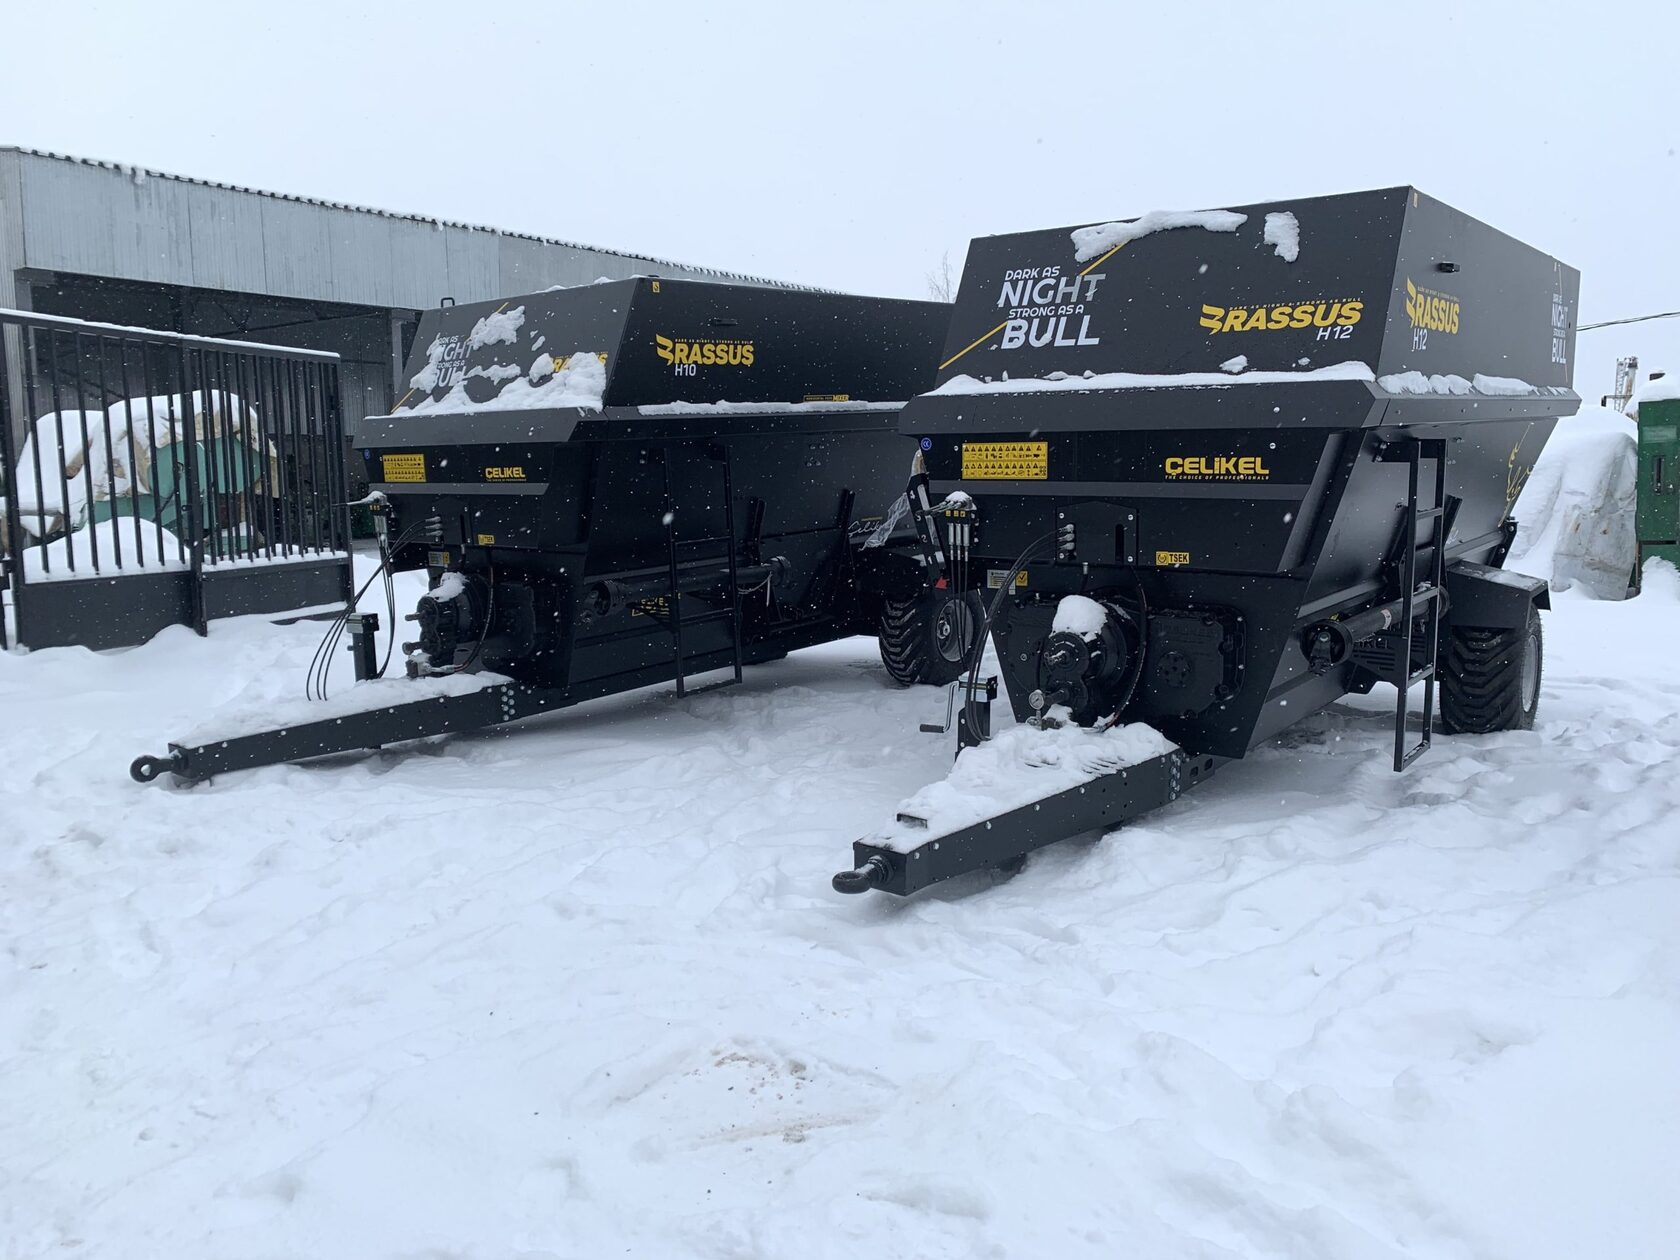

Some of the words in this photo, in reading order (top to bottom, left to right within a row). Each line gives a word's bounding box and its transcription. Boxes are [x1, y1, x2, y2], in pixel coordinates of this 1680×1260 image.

[1005, 268, 1041, 281] DARK
[1042, 266, 1061, 278] AS
[997, 274, 1107, 308] NIGHT
[1008, 306, 1056, 319] STRONG
[1057, 305, 1074, 316] AS
[1075, 304, 1085, 315] A
[1001, 315, 1100, 349] BULL
[1316, 325, 1354, 341] H12
[1412, 328, 1428, 350] H12
[674, 364, 697, 377] H10
[1169, 553, 1188, 562] TSEK
